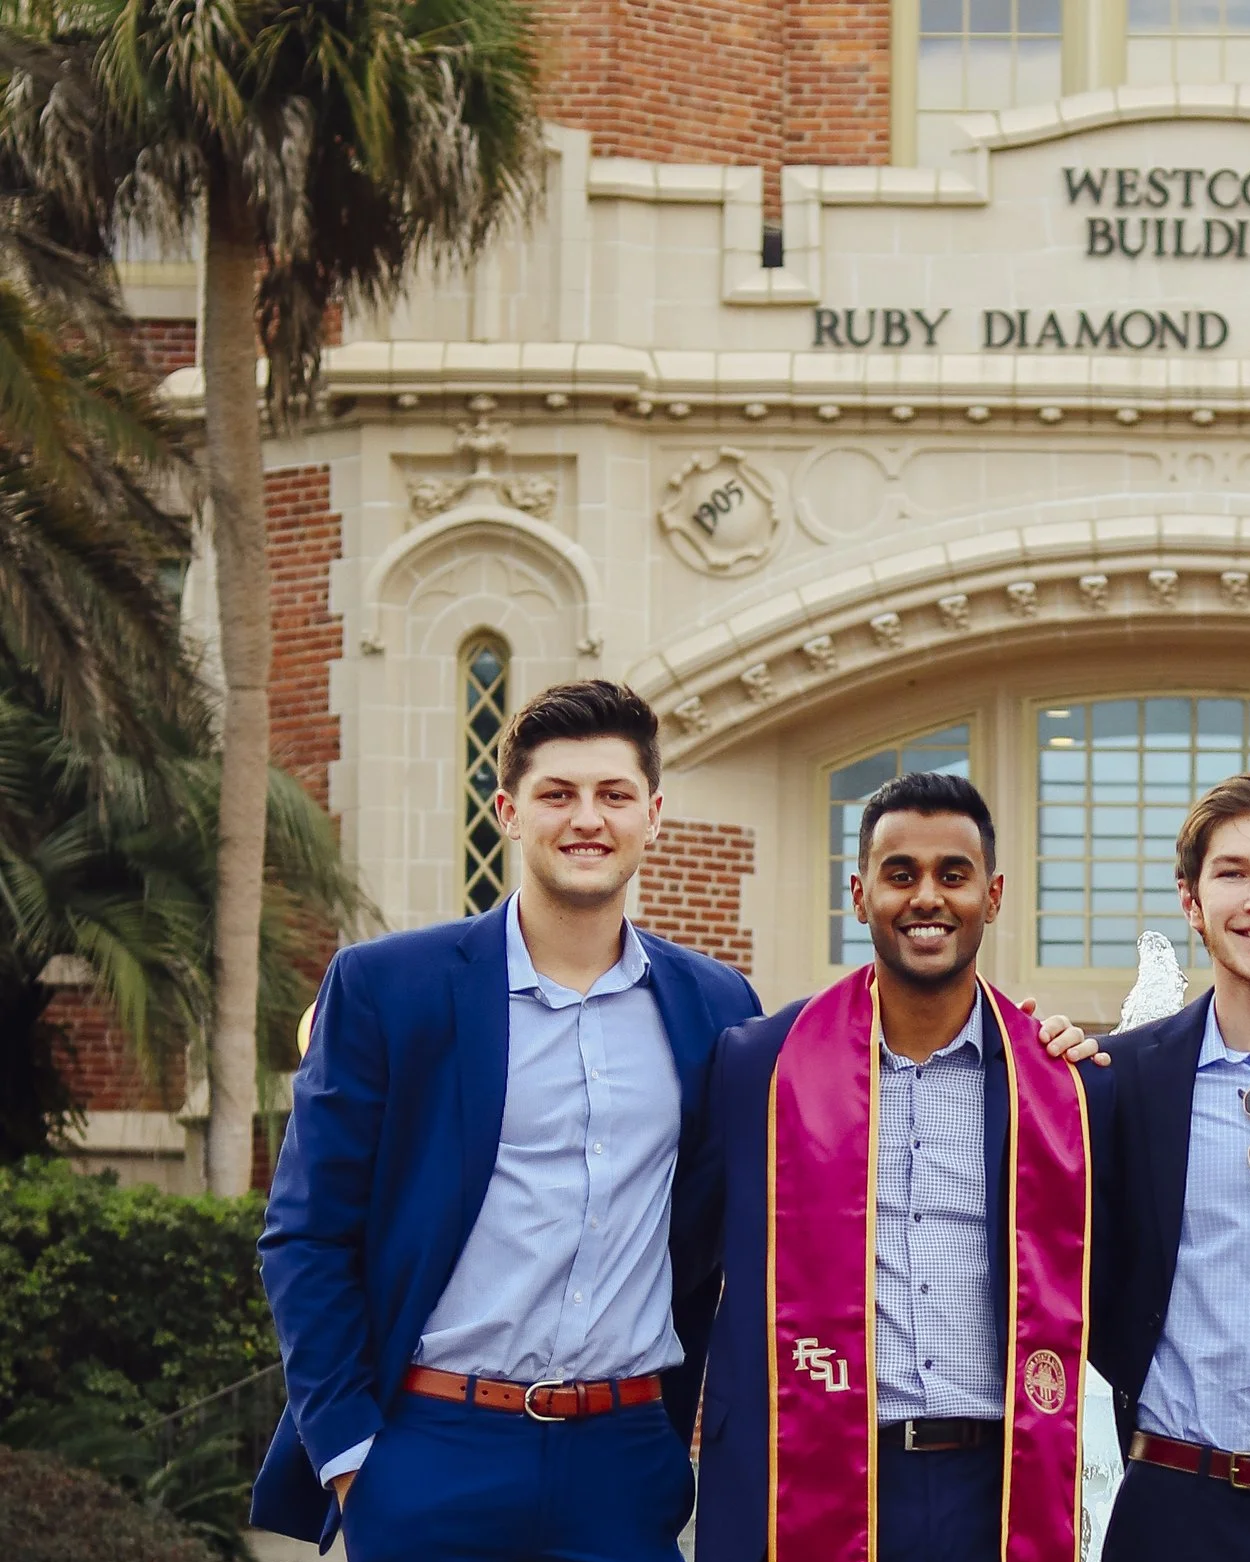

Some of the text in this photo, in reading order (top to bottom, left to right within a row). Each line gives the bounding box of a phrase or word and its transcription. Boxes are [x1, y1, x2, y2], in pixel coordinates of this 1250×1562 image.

[812, 307, 952, 349] RUBY
[983, 308, 1230, 351] DIAMOND
[692, 479, 744, 536] 1905
[792, 1337, 850, 1392] FSU
